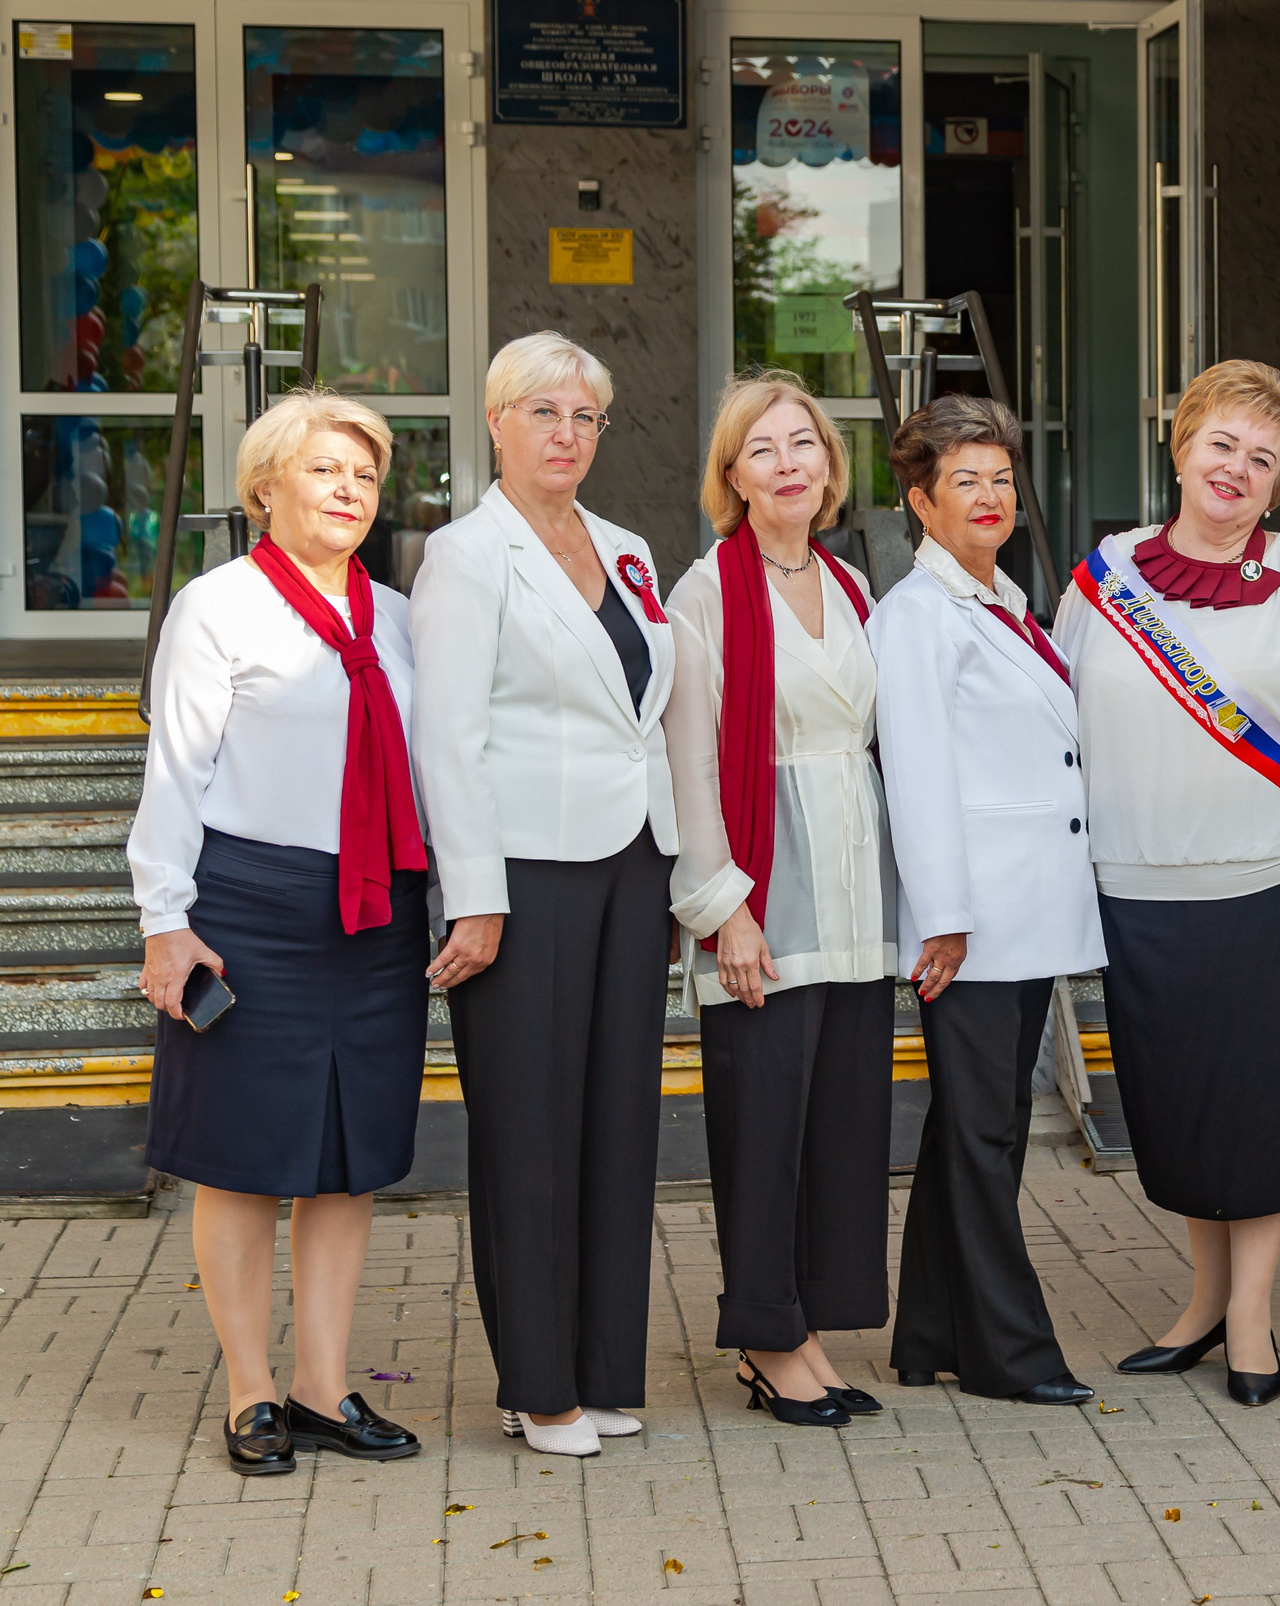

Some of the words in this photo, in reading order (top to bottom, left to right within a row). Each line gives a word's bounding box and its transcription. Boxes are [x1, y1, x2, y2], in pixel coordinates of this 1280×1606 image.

[541, 71, 593, 84] ШКОЛА
[769, 118, 834, 138] 2024
[1112, 591, 1218, 695] Директор
